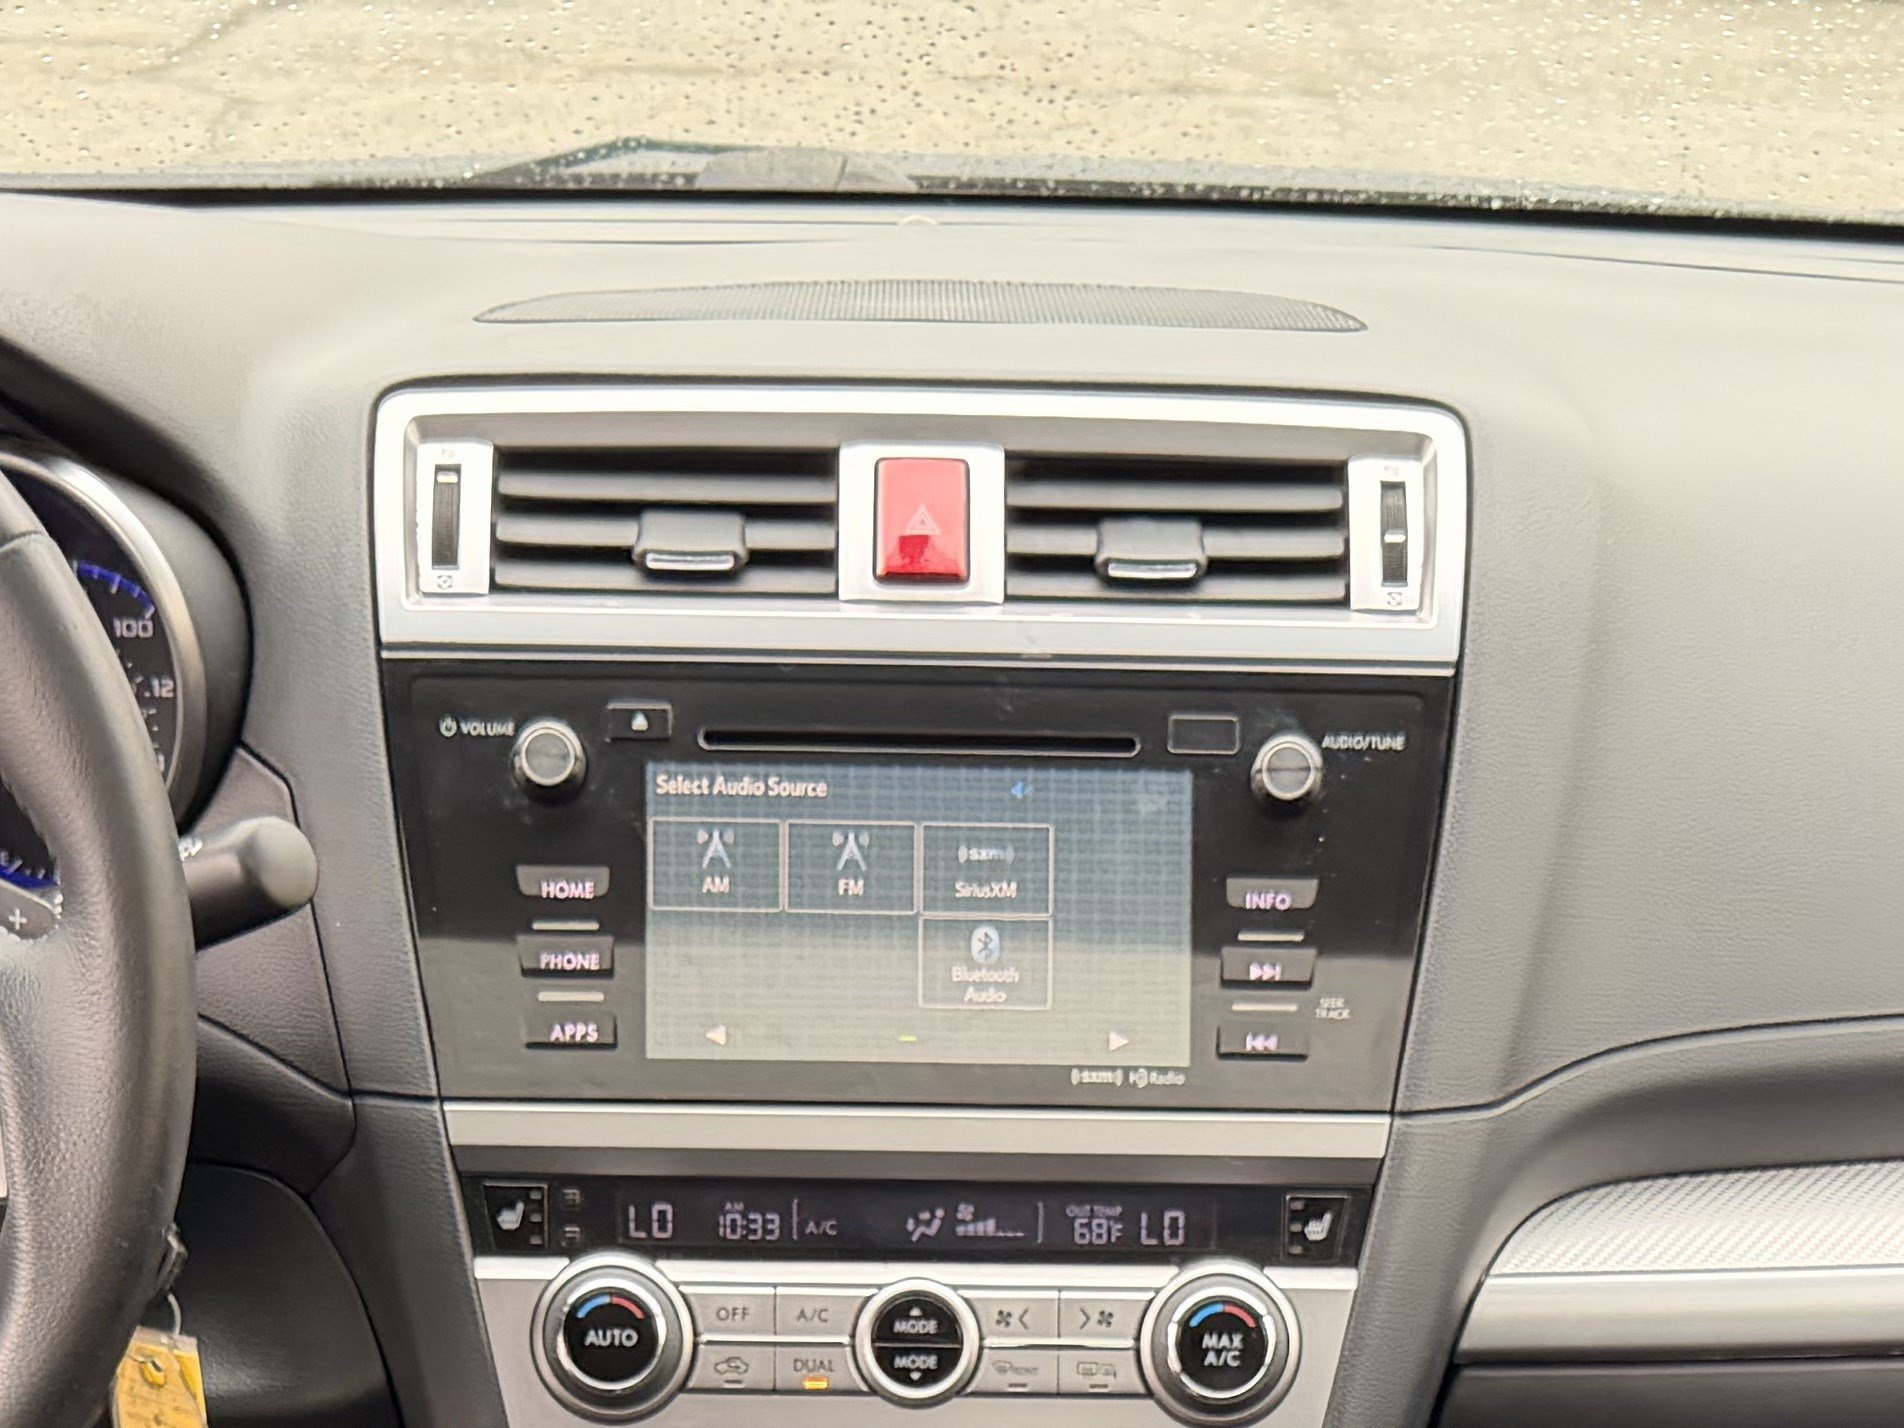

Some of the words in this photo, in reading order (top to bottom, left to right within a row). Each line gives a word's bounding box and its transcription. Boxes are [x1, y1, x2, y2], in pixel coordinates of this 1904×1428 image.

[112, 618, 154, 638] 100
[460, 720, 516, 737] VOLUME
[1322, 733, 1406, 750] AUDIO/TUNE
[656, 776, 709, 796] Select
[713, 777, 765, 797] Audio
[768, 778, 827, 798] Source
[541, 881, 594, 899] HOME
[702, 878, 730, 894] AM
[838, 879, 864, 896] FM
[955, 881, 1018, 899] SiriusXM
[1246, 892, 1292, 910] INFO
[540, 953, 600, 970] PHONE
[951, 965, 1019, 983] Bluetooth
[550, 1023, 598, 1041] APPS
[718, 1213, 781, 1240] 10:33
[805, 1221, 838, 1236] A/C
[715, 1307, 750, 1322] OFF
[797, 1307, 829, 1323] A/C
[895, 1319, 938, 1335] MODE
[585, 1329, 639, 1347] AUTO
[1202, 1333, 1243, 1350] MAX
[895, 1354, 938, 1370] MODE
[1204, 1350, 1241, 1368] A/C
